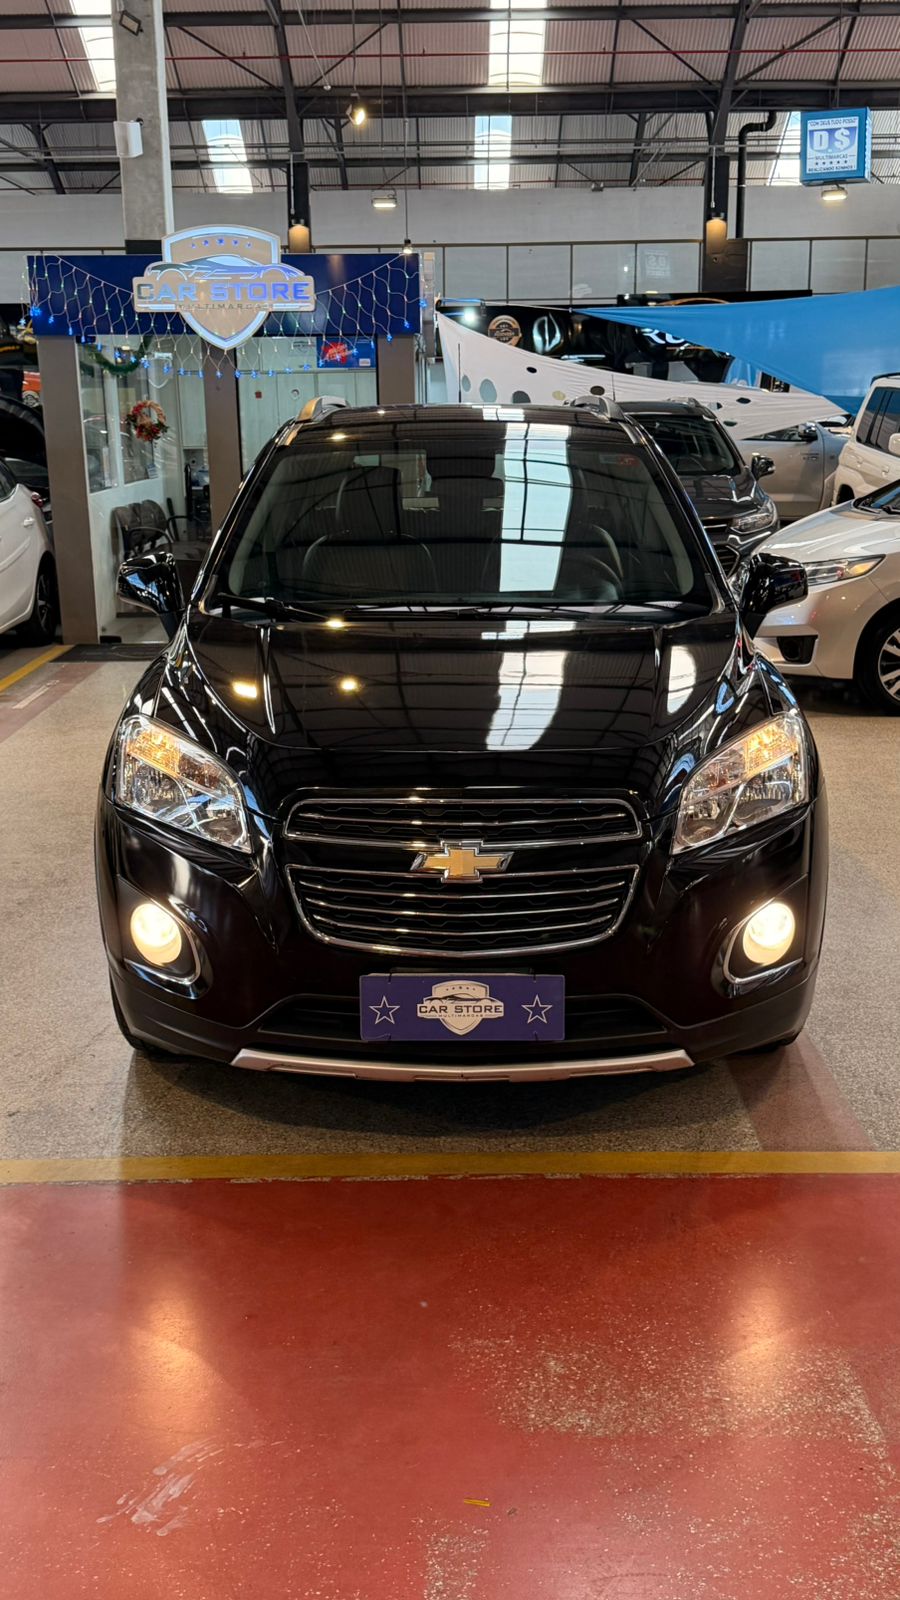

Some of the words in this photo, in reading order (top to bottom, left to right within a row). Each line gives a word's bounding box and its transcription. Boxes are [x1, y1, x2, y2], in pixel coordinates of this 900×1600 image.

[136, 283, 198, 302] CAR
[210, 282, 310, 302] STORE
[419, 1005, 448, 1014] CAR
[454, 1005, 503, 1014] STORE
